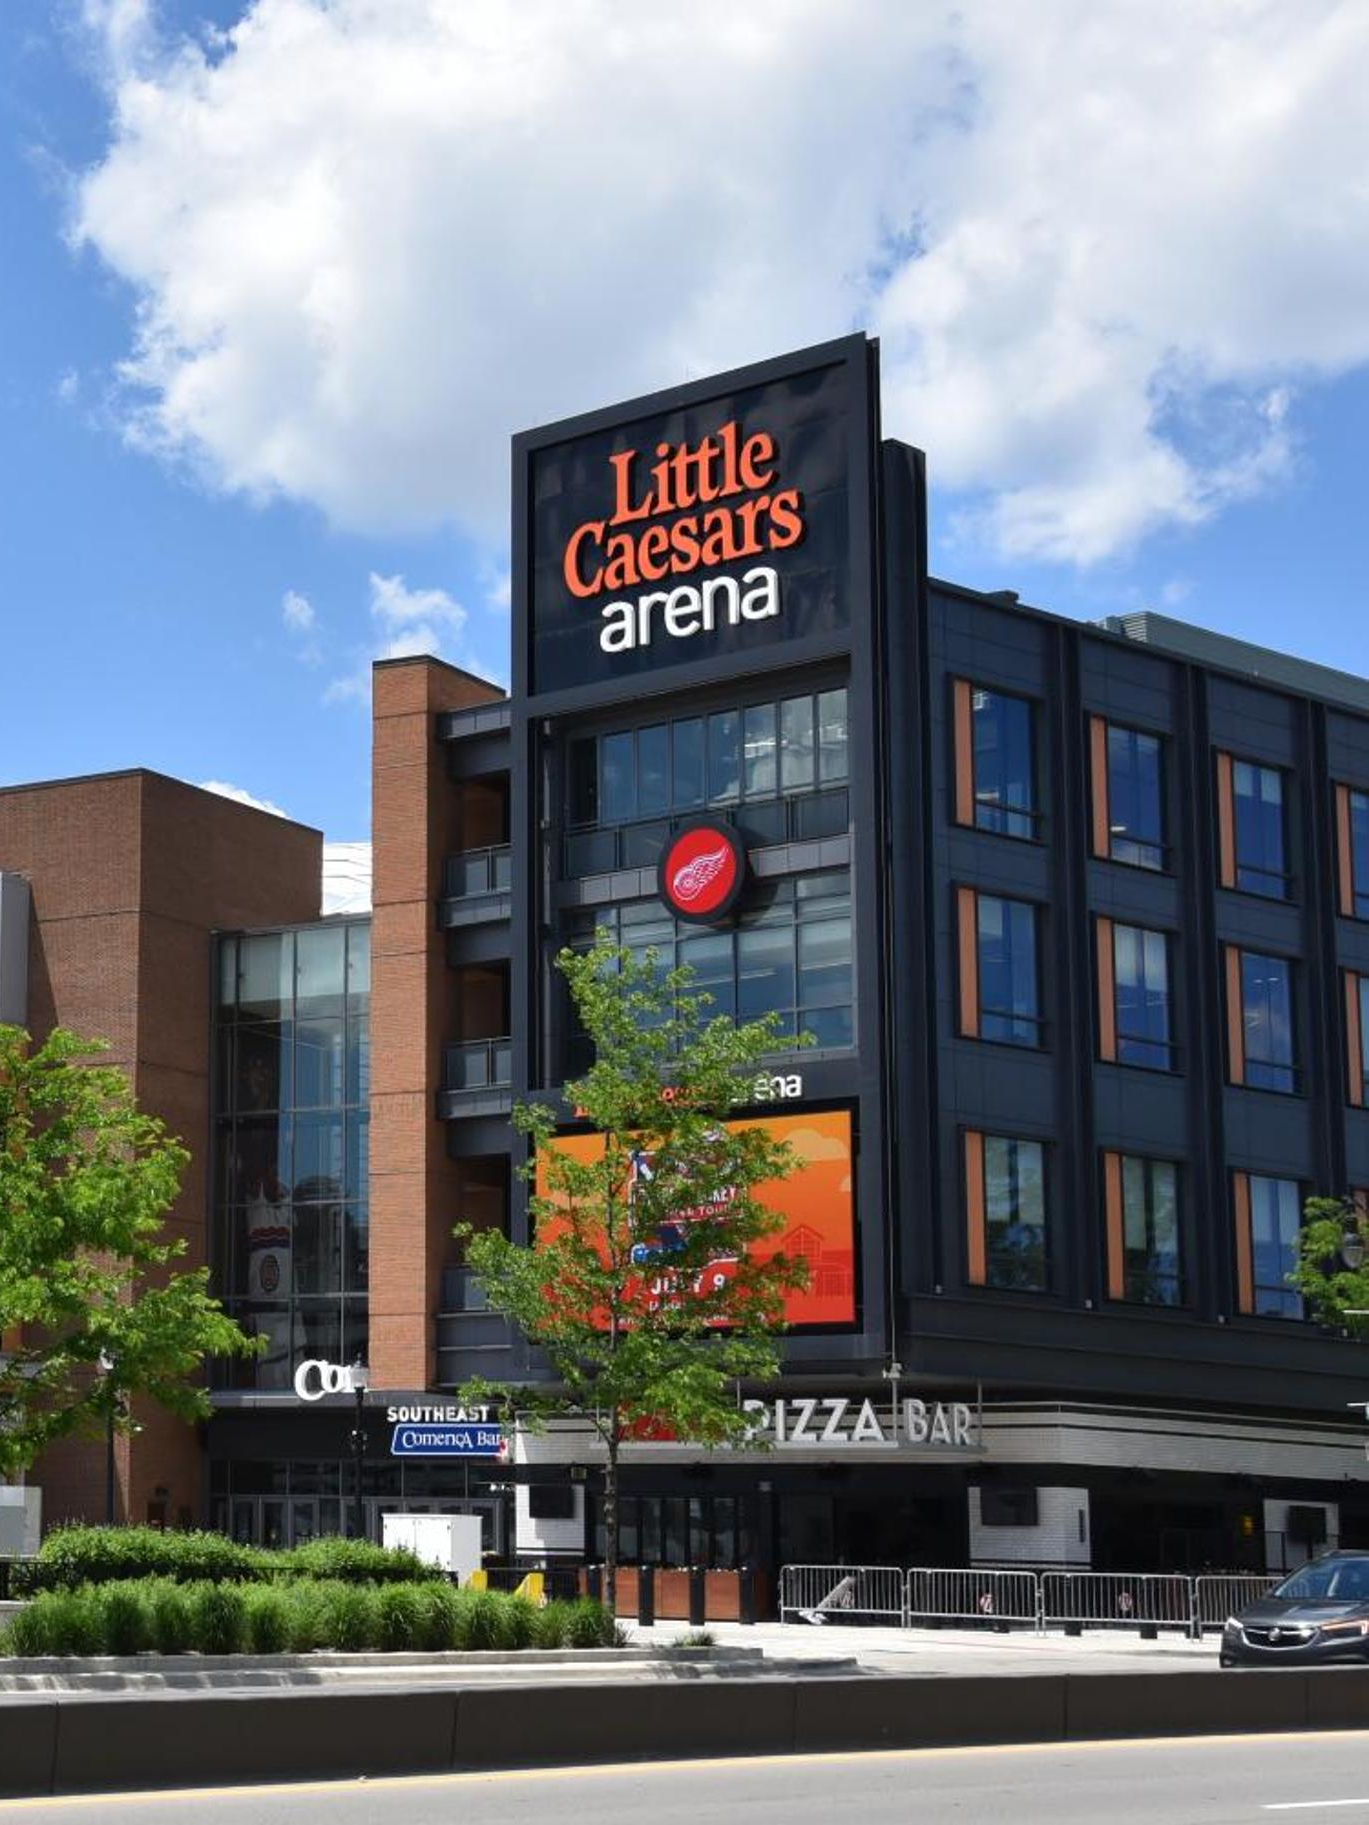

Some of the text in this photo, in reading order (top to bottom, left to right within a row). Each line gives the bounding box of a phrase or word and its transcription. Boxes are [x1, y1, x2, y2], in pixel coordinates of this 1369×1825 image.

[609, 421, 775, 526] Little
[564, 488, 803, 598] Caesars
[600, 567, 779, 652] arena
[386, 1405, 490, 1423] SOUTHEAST
[743, 1397, 972, 1446] PIZZA BAR
